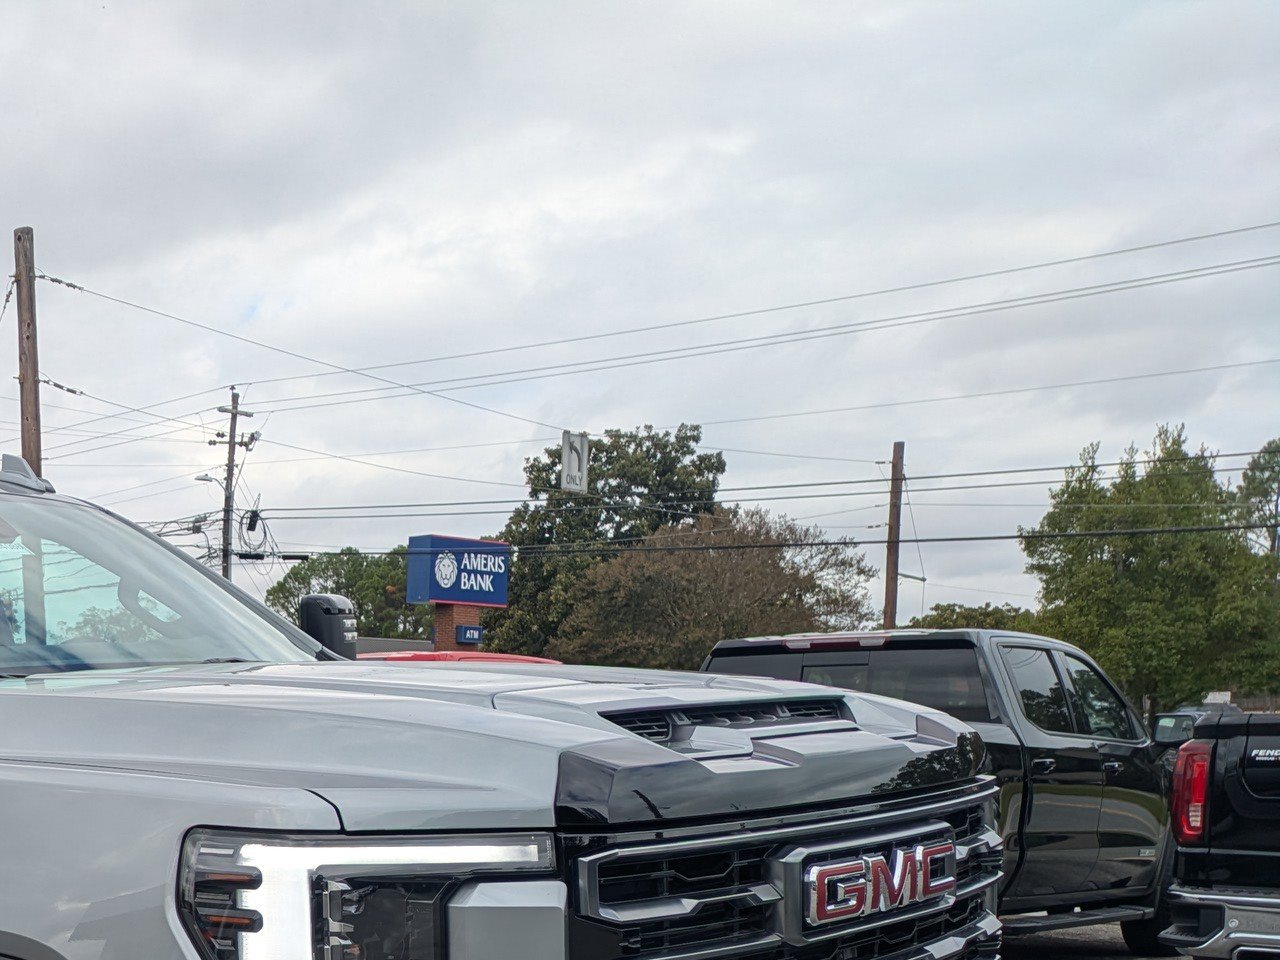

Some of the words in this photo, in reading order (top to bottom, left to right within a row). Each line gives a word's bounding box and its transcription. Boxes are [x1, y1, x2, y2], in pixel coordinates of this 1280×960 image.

[566, 473, 583, 486] ONLY
[461, 553, 505, 573] AMERIS
[460, 573, 494, 592] BANK
[465, 629, 479, 639] ATM
[805, 840, 956, 926] GMC
